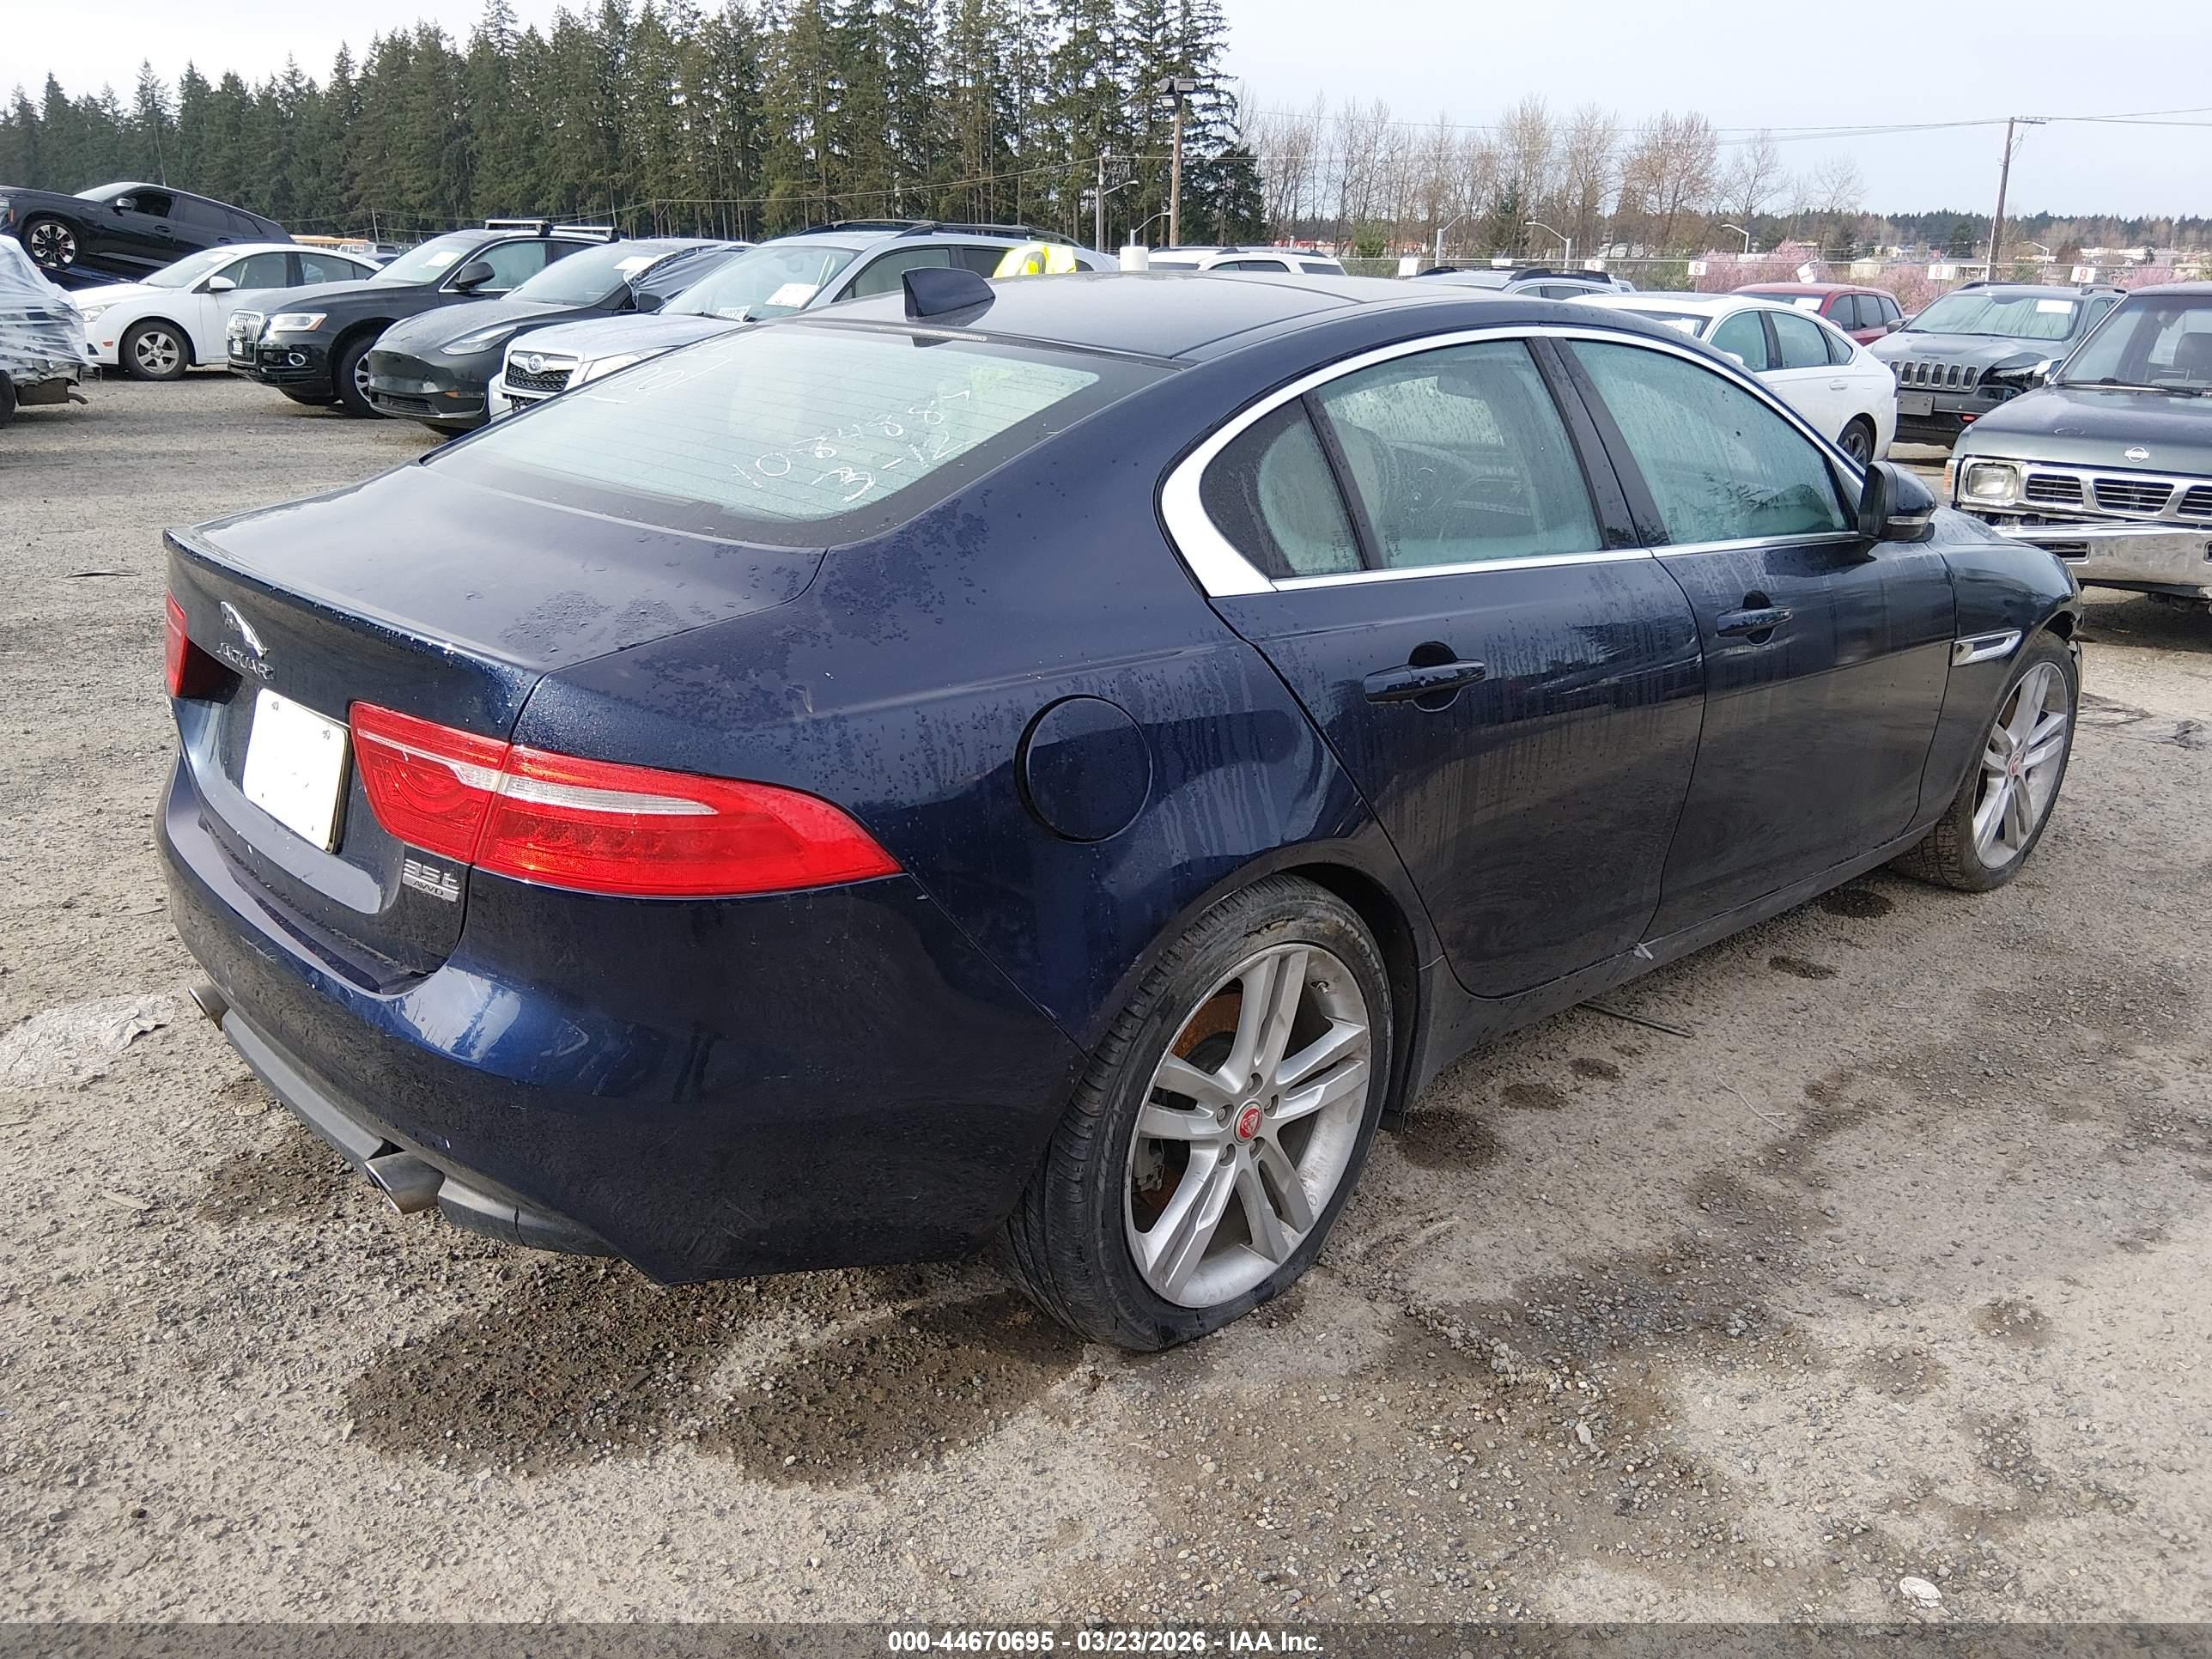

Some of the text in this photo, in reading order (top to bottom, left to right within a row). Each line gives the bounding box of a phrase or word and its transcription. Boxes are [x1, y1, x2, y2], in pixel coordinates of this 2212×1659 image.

[1693, 263, 1701, 274] 6
[215, 642, 275, 680] JAGUAR
[403, 858, 461, 890] 35t
[412, 879, 445, 896] AWD
